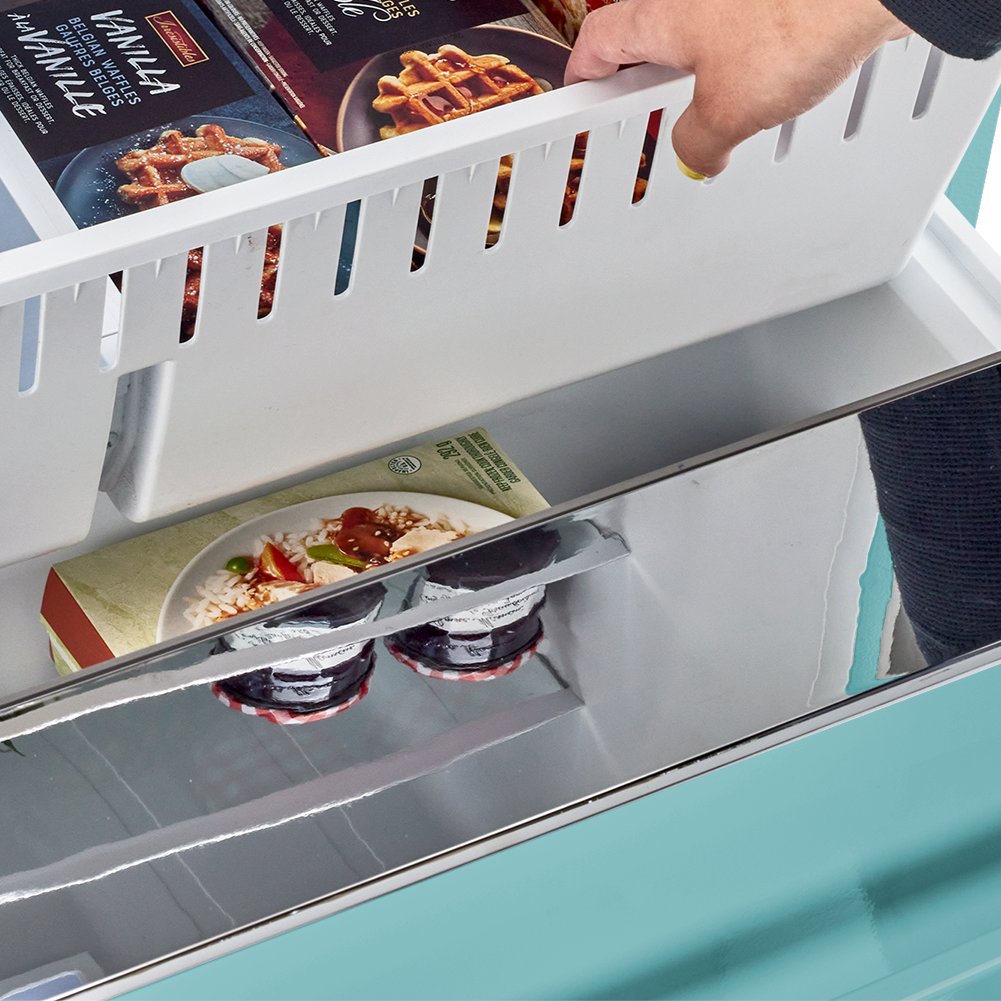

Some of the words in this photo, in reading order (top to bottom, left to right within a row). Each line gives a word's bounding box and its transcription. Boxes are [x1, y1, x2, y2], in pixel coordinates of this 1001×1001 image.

[284, 1, 293, 9] OU
[317, 2, 336, 22] WAFFLES
[7, 13, 30, 21] À
[16, 22, 35, 33] LA
[152, 16, 200, 63] Irresistibles
[319, 33, 332, 46] POUR
[69, 17, 106, 57] BELGIAN
[102, 59, 141, 105] WAFFLES
[91, 10, 179, 94] VANILLA
[19, 31, 105, 117] VANILLE
[56, 24, 95, 67] GAUFRES
[89, 69, 124, 107] BELGES
[5, 59, 15, 69] FOR
[12, 69, 34, 94] BREAKFAST
[11, 55, 24, 68] THICK
[20, 69, 38, 88] BELGIAN
[35, 88, 54, 109] WAFFLES
[1, 86, 11, 95] OU
[35, 121, 49, 134] POUR
[440, 444, 461, 460] 292
